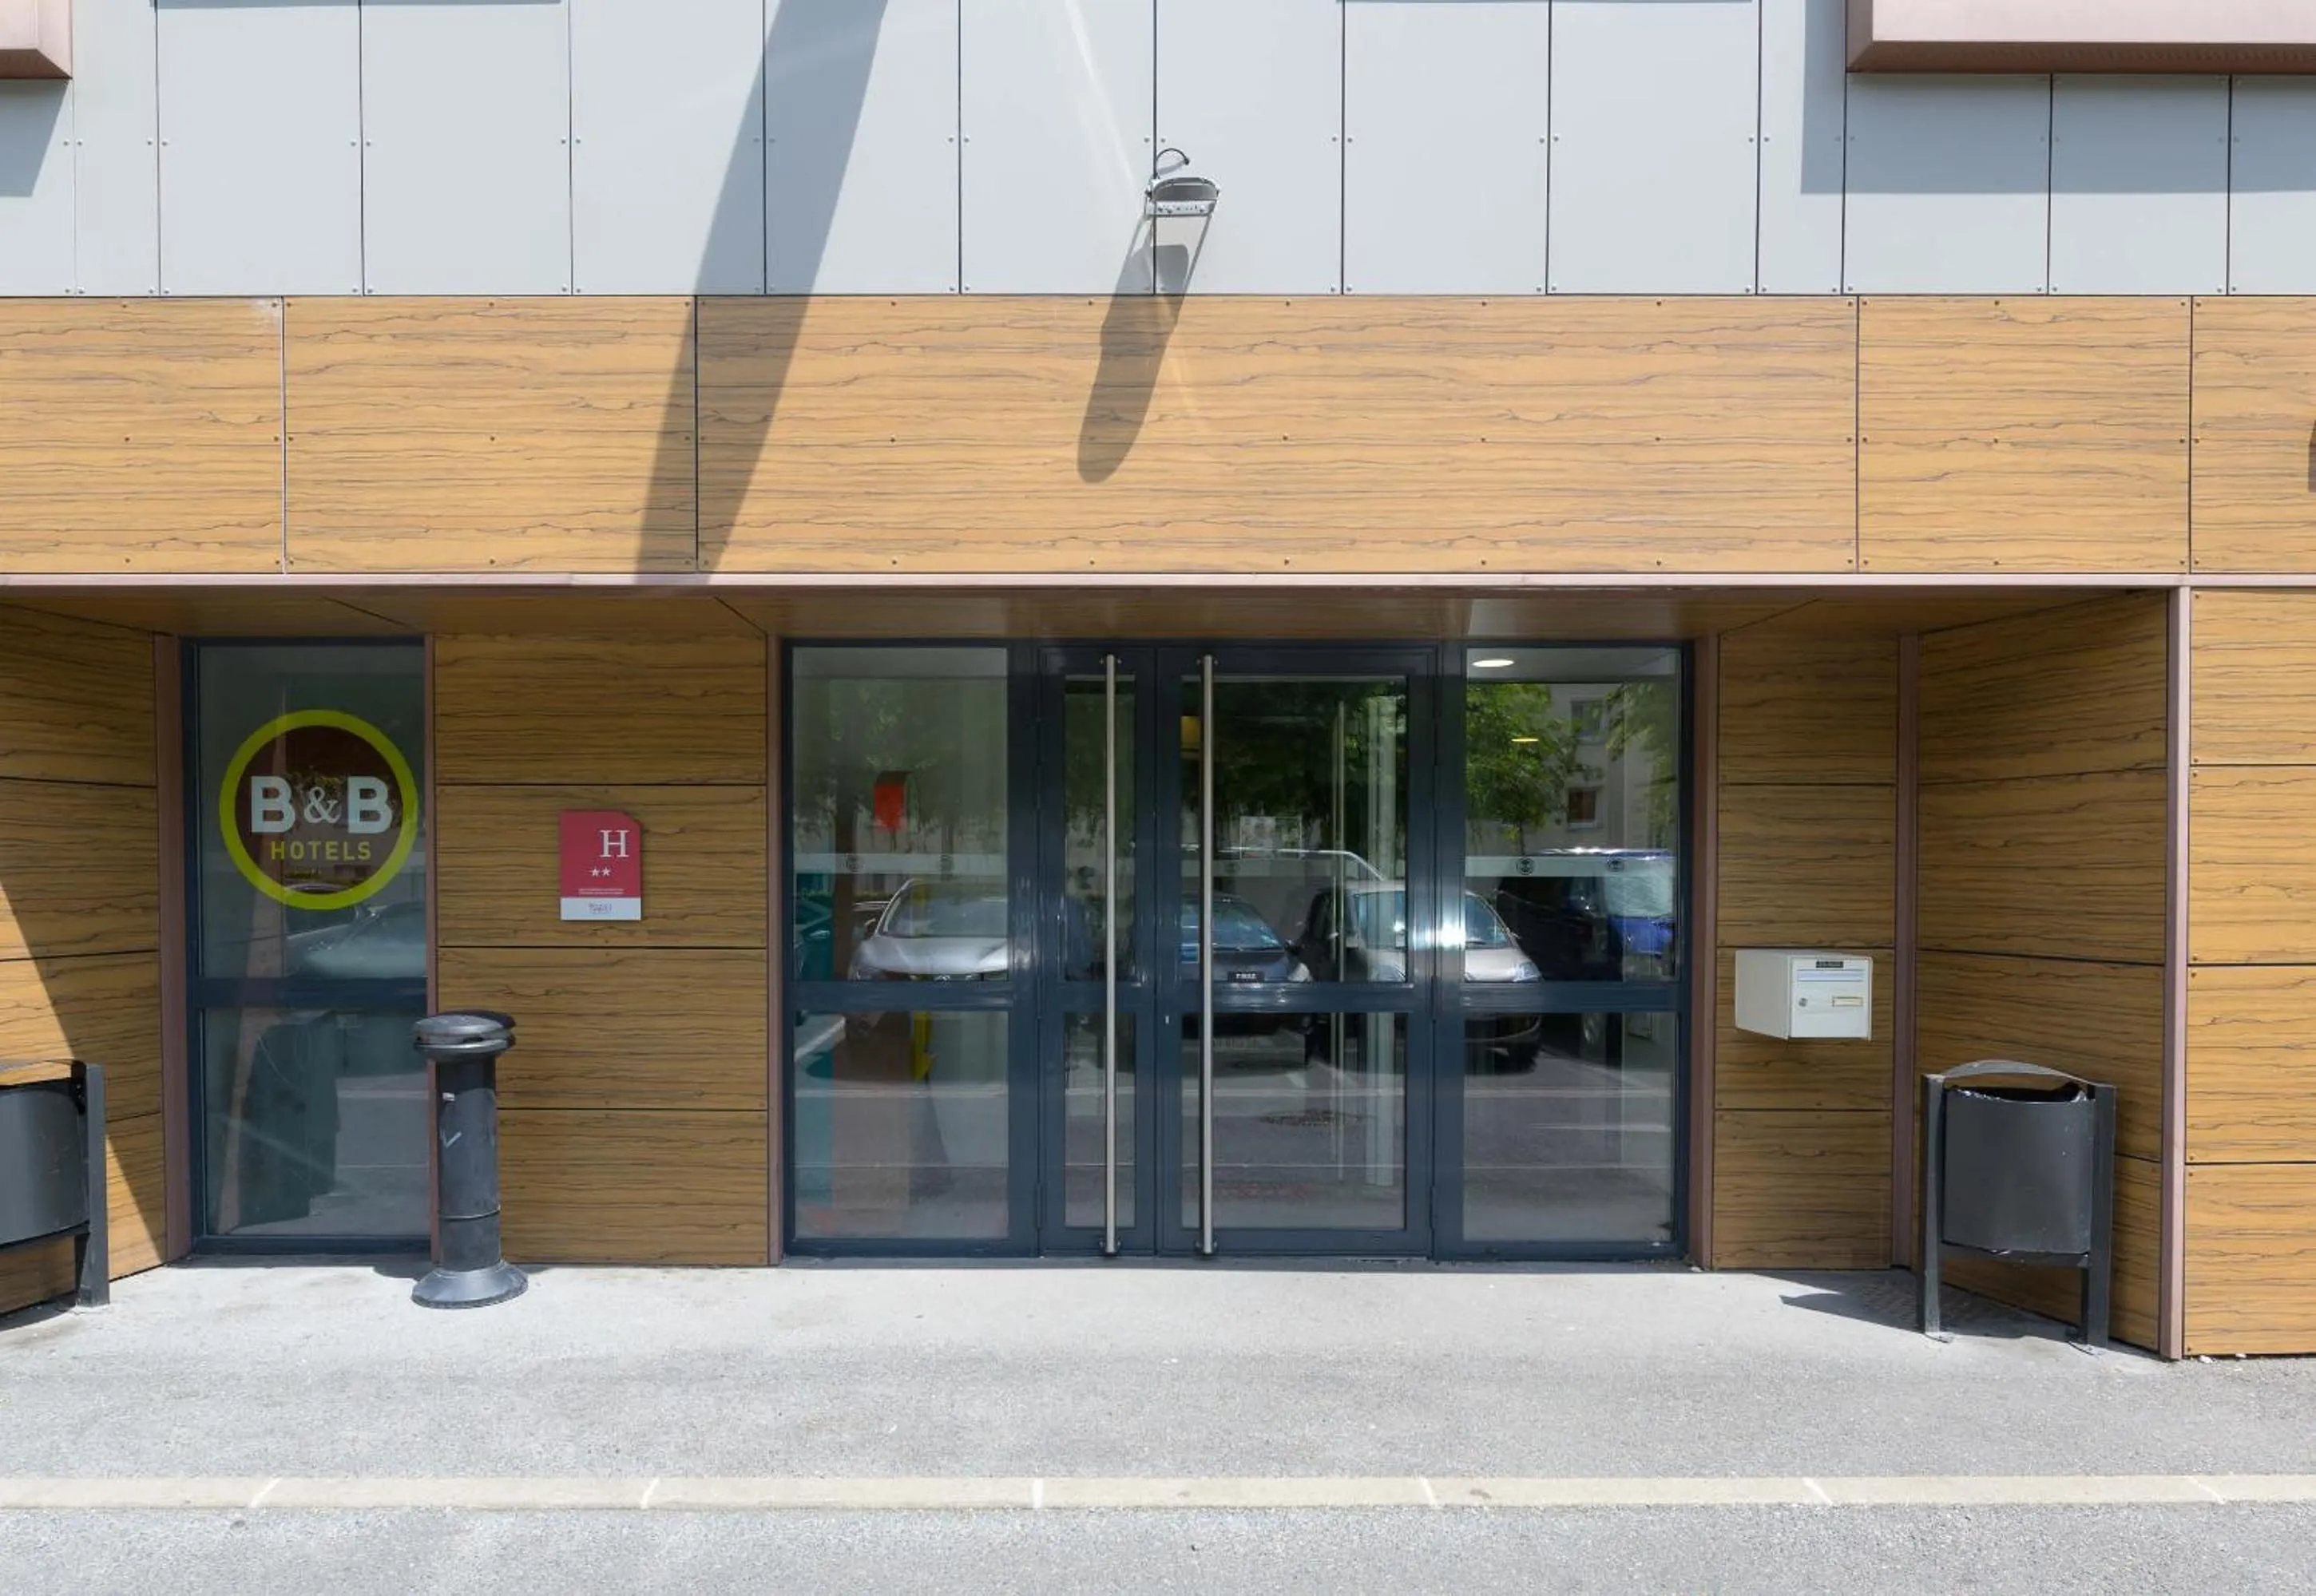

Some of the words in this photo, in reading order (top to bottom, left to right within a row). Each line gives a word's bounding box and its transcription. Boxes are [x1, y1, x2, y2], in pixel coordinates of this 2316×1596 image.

[252, 776, 392, 834] B&B
[271, 841, 371, 860] HOTELS
[600, 830, 629, 857] H
